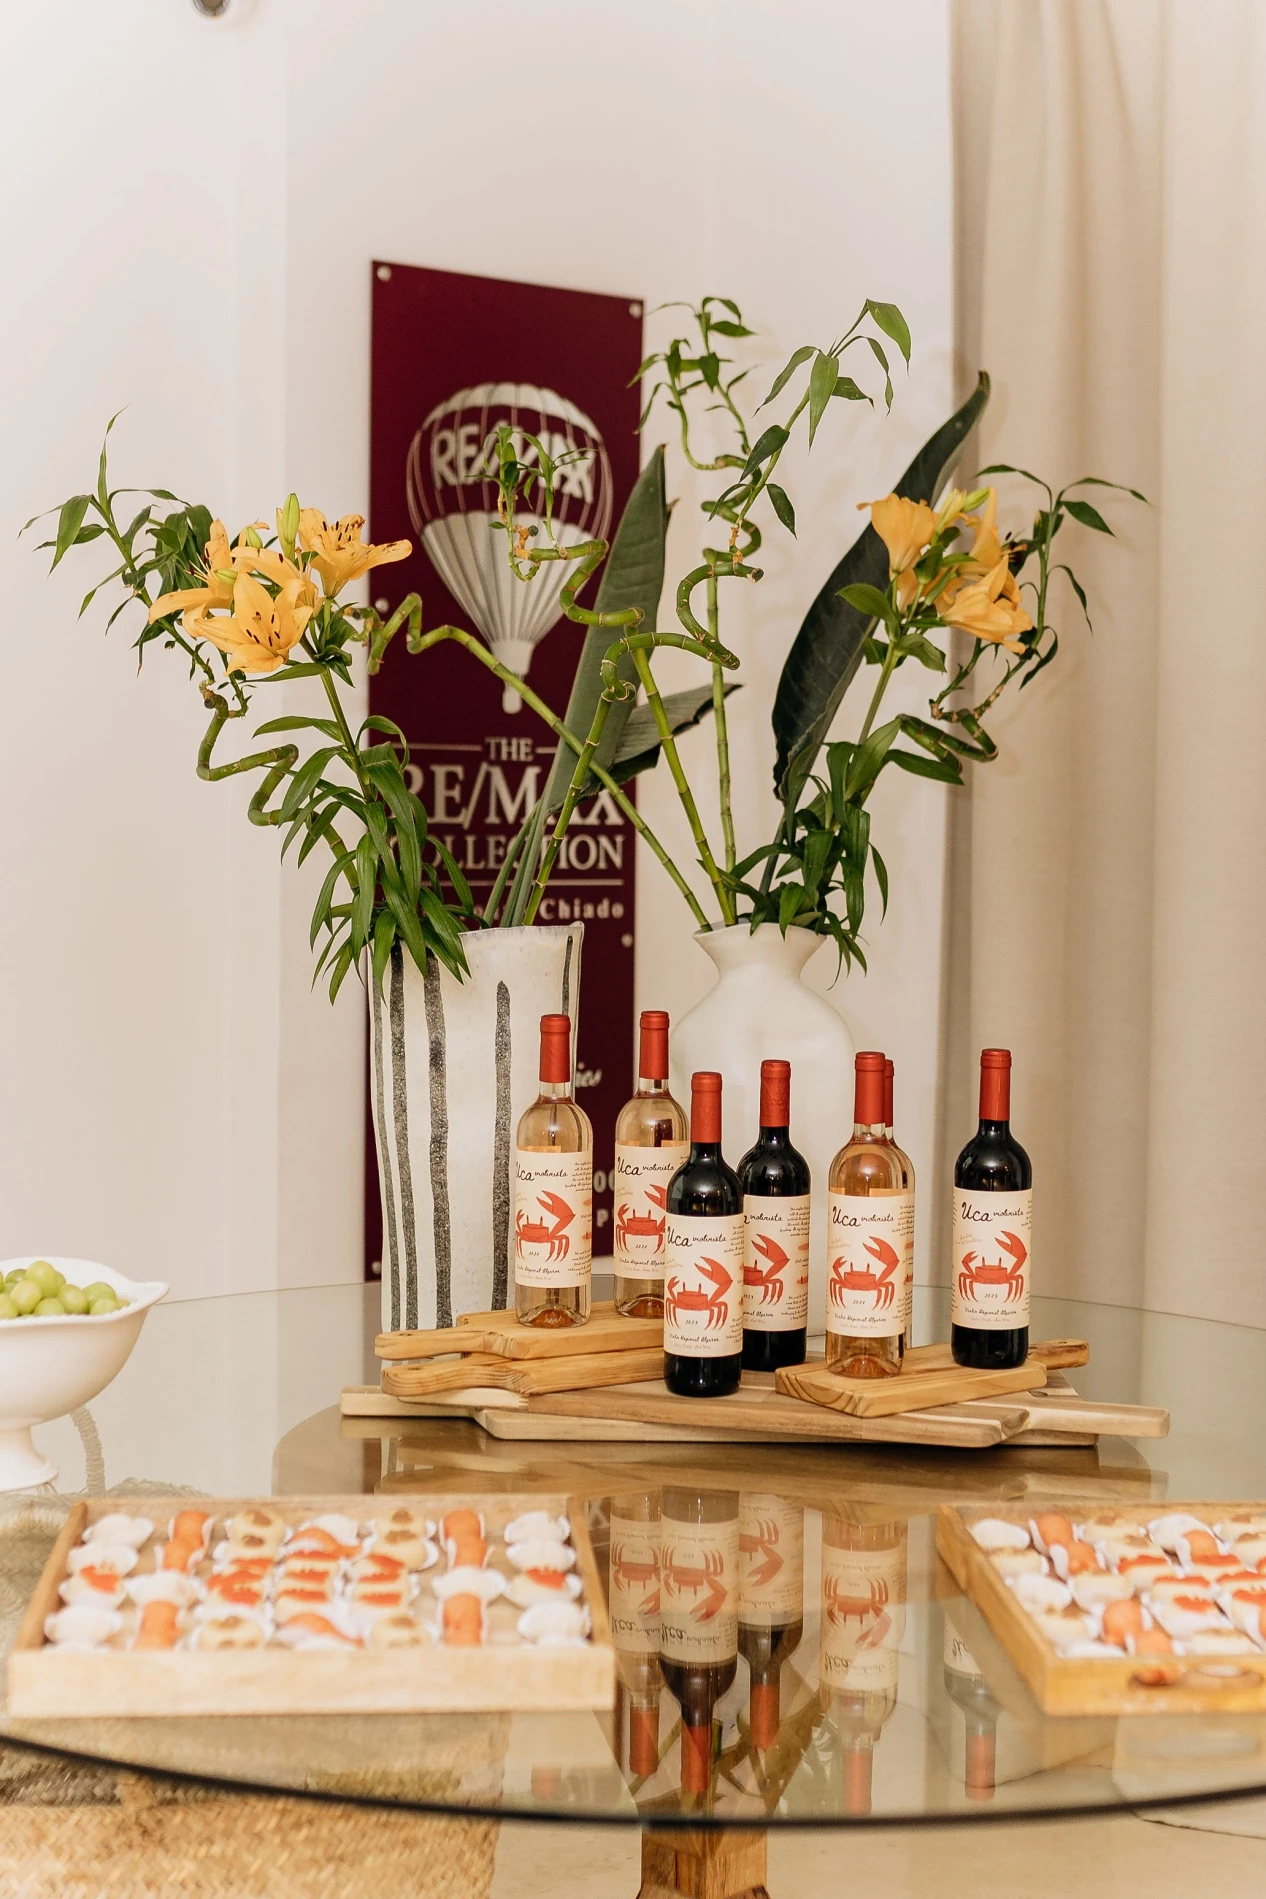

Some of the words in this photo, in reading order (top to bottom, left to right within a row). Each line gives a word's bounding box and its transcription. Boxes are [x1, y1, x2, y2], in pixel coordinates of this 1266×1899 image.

[485, 736, 535, 763] THE
[539, 898, 624, 920] Chiado
[516, 1161, 534, 1182] Uca
[534, 1168, 568, 1178] violinista
[617, 1155, 642, 1176] Uca
[642, 1163, 675, 1171] violinista
[832, 1205, 860, 1228] Uca
[861, 1213, 894, 1222] violinista
[962, 1201, 993, 1222] Uca
[993, 1208, 1024, 1217] violinista
[667, 1226, 692, 1247] Uca
[692, 1233, 727, 1243] violinista
